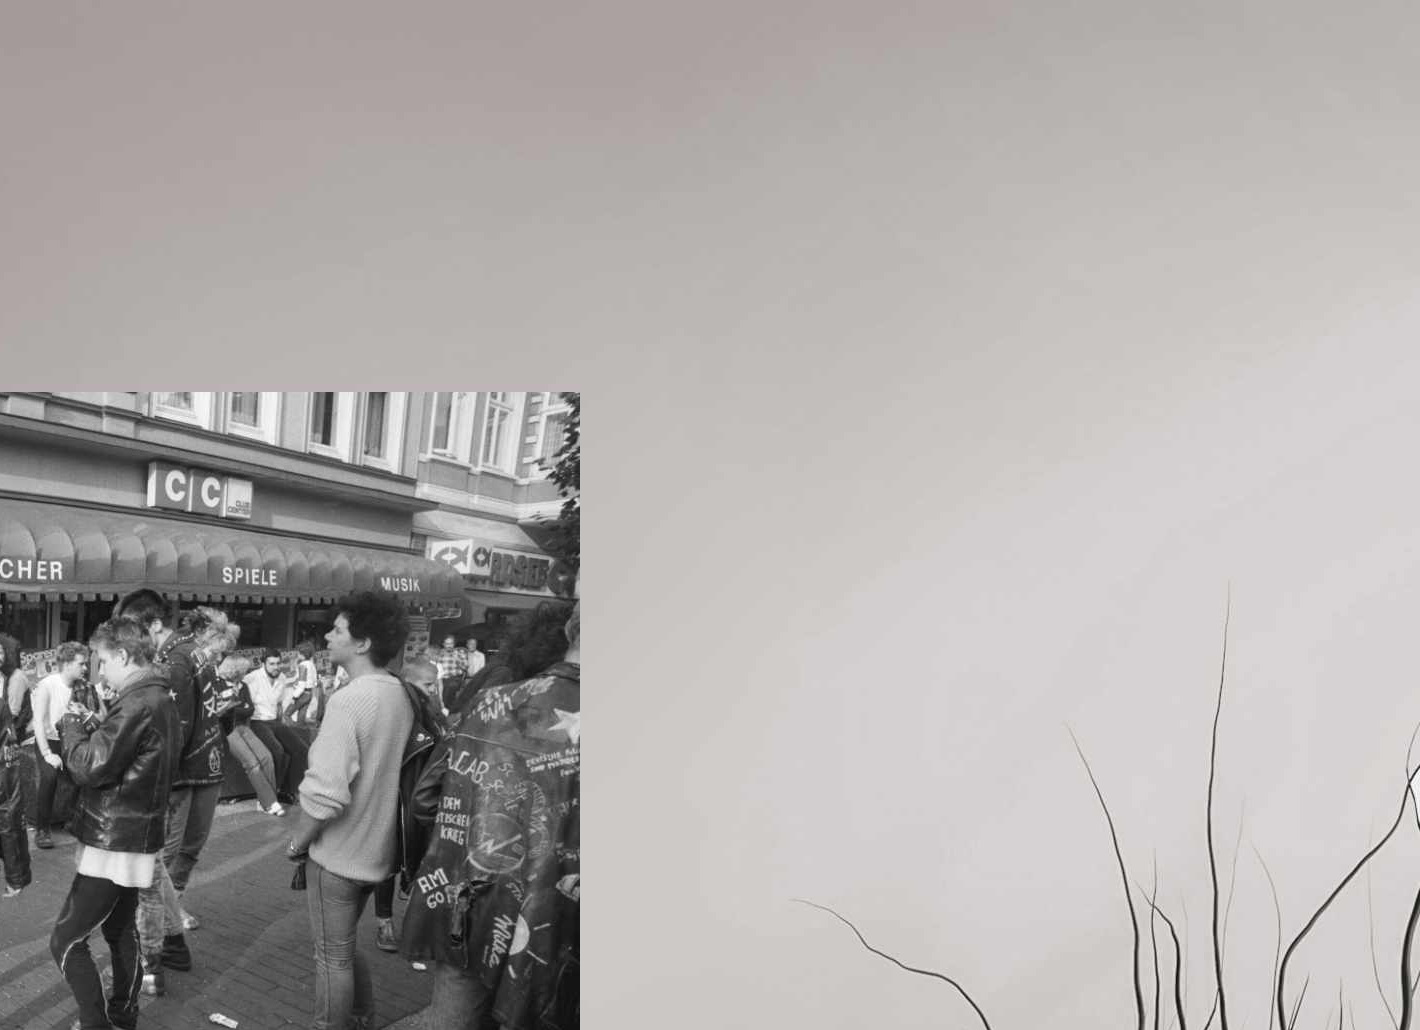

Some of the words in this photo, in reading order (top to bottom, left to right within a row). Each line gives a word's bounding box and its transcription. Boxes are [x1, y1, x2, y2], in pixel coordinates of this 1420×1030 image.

[165, 469, 187, 502] C
[201, 476, 221, 508] C
[222, 566, 278, 586] SPIELE
[380, 576, 422, 593] MUSIK
[20, 649, 57, 666] Sparen
[443, 796, 462, 811] DEM
[417, 867, 450, 894] AMI
